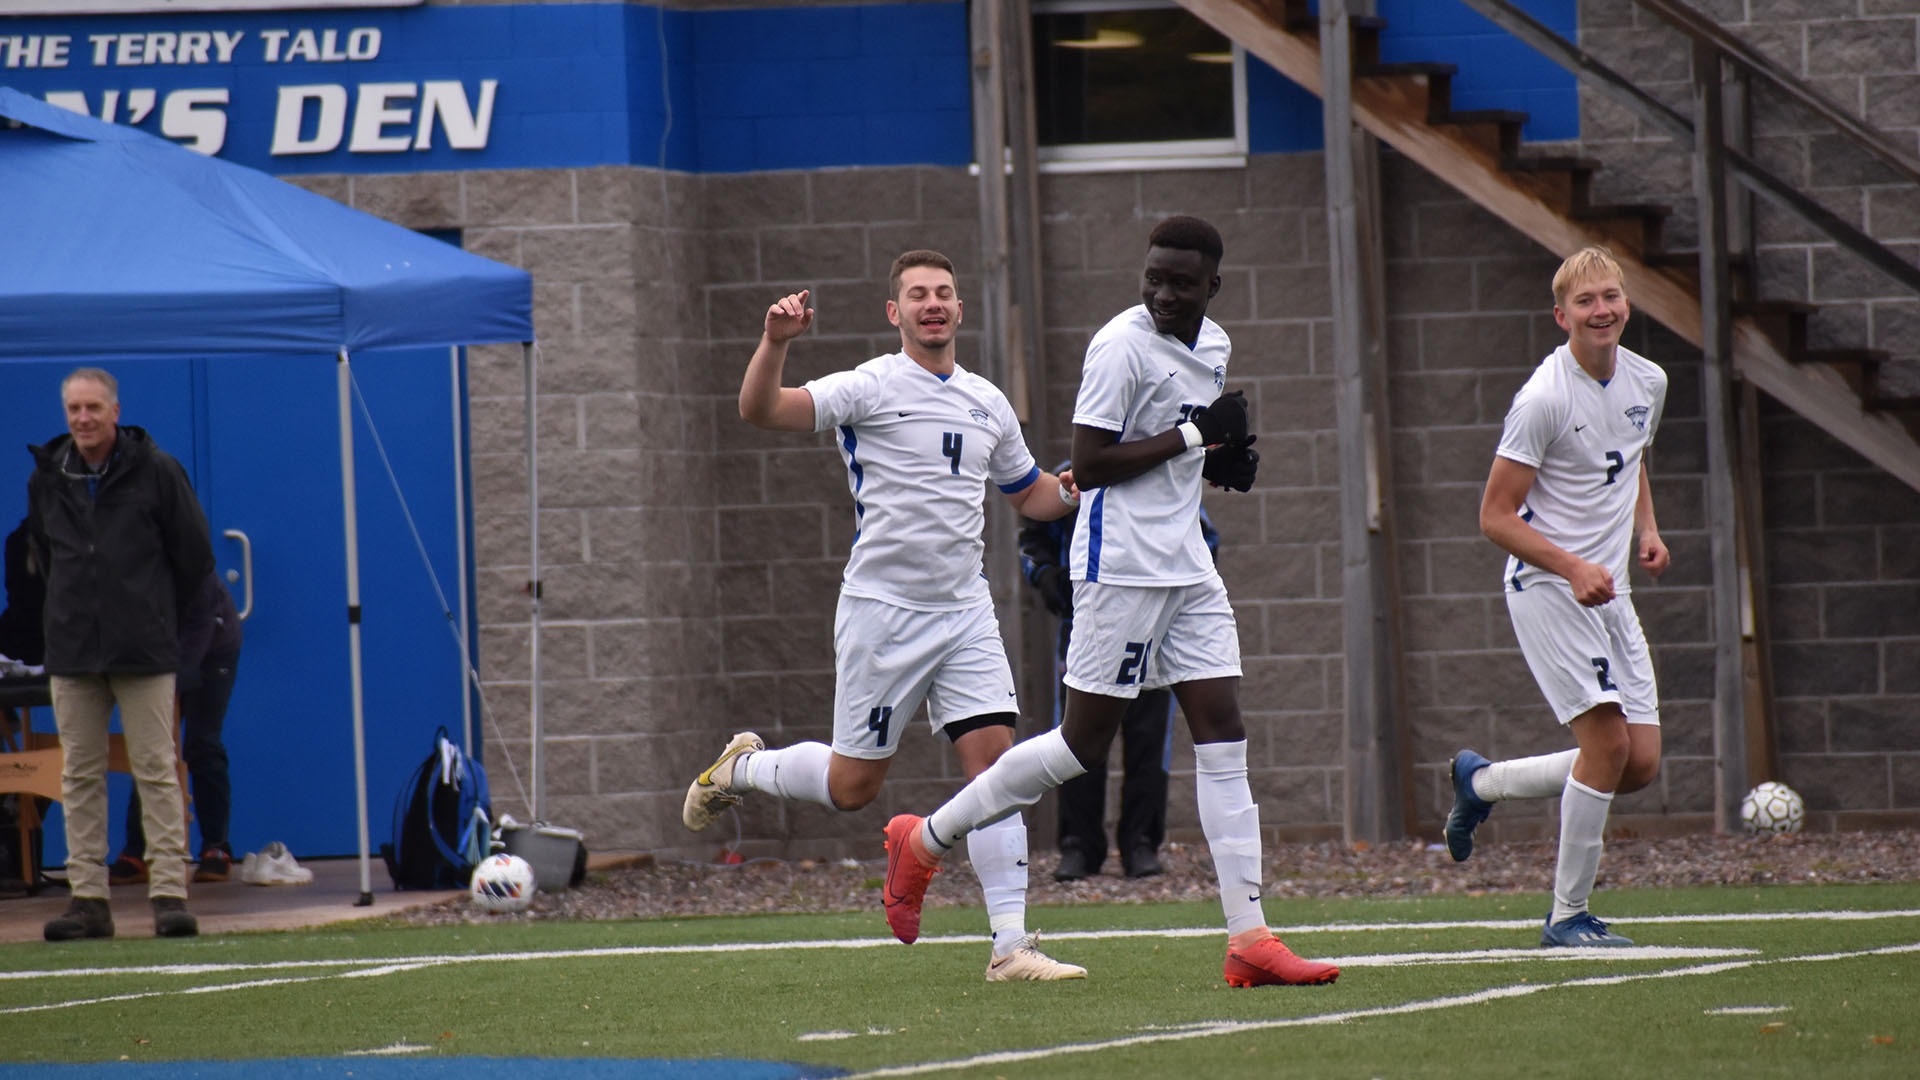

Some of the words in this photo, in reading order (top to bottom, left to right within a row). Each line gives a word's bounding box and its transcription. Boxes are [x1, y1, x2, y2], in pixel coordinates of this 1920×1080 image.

[89, 31, 244, 66] TERRY
[260, 27, 382, 62] TALO
[270, 79, 498, 155] DEN
[942, 432, 963, 475] 4
[1591, 657, 1618, 692] 2
[868, 706, 893, 748] 4
